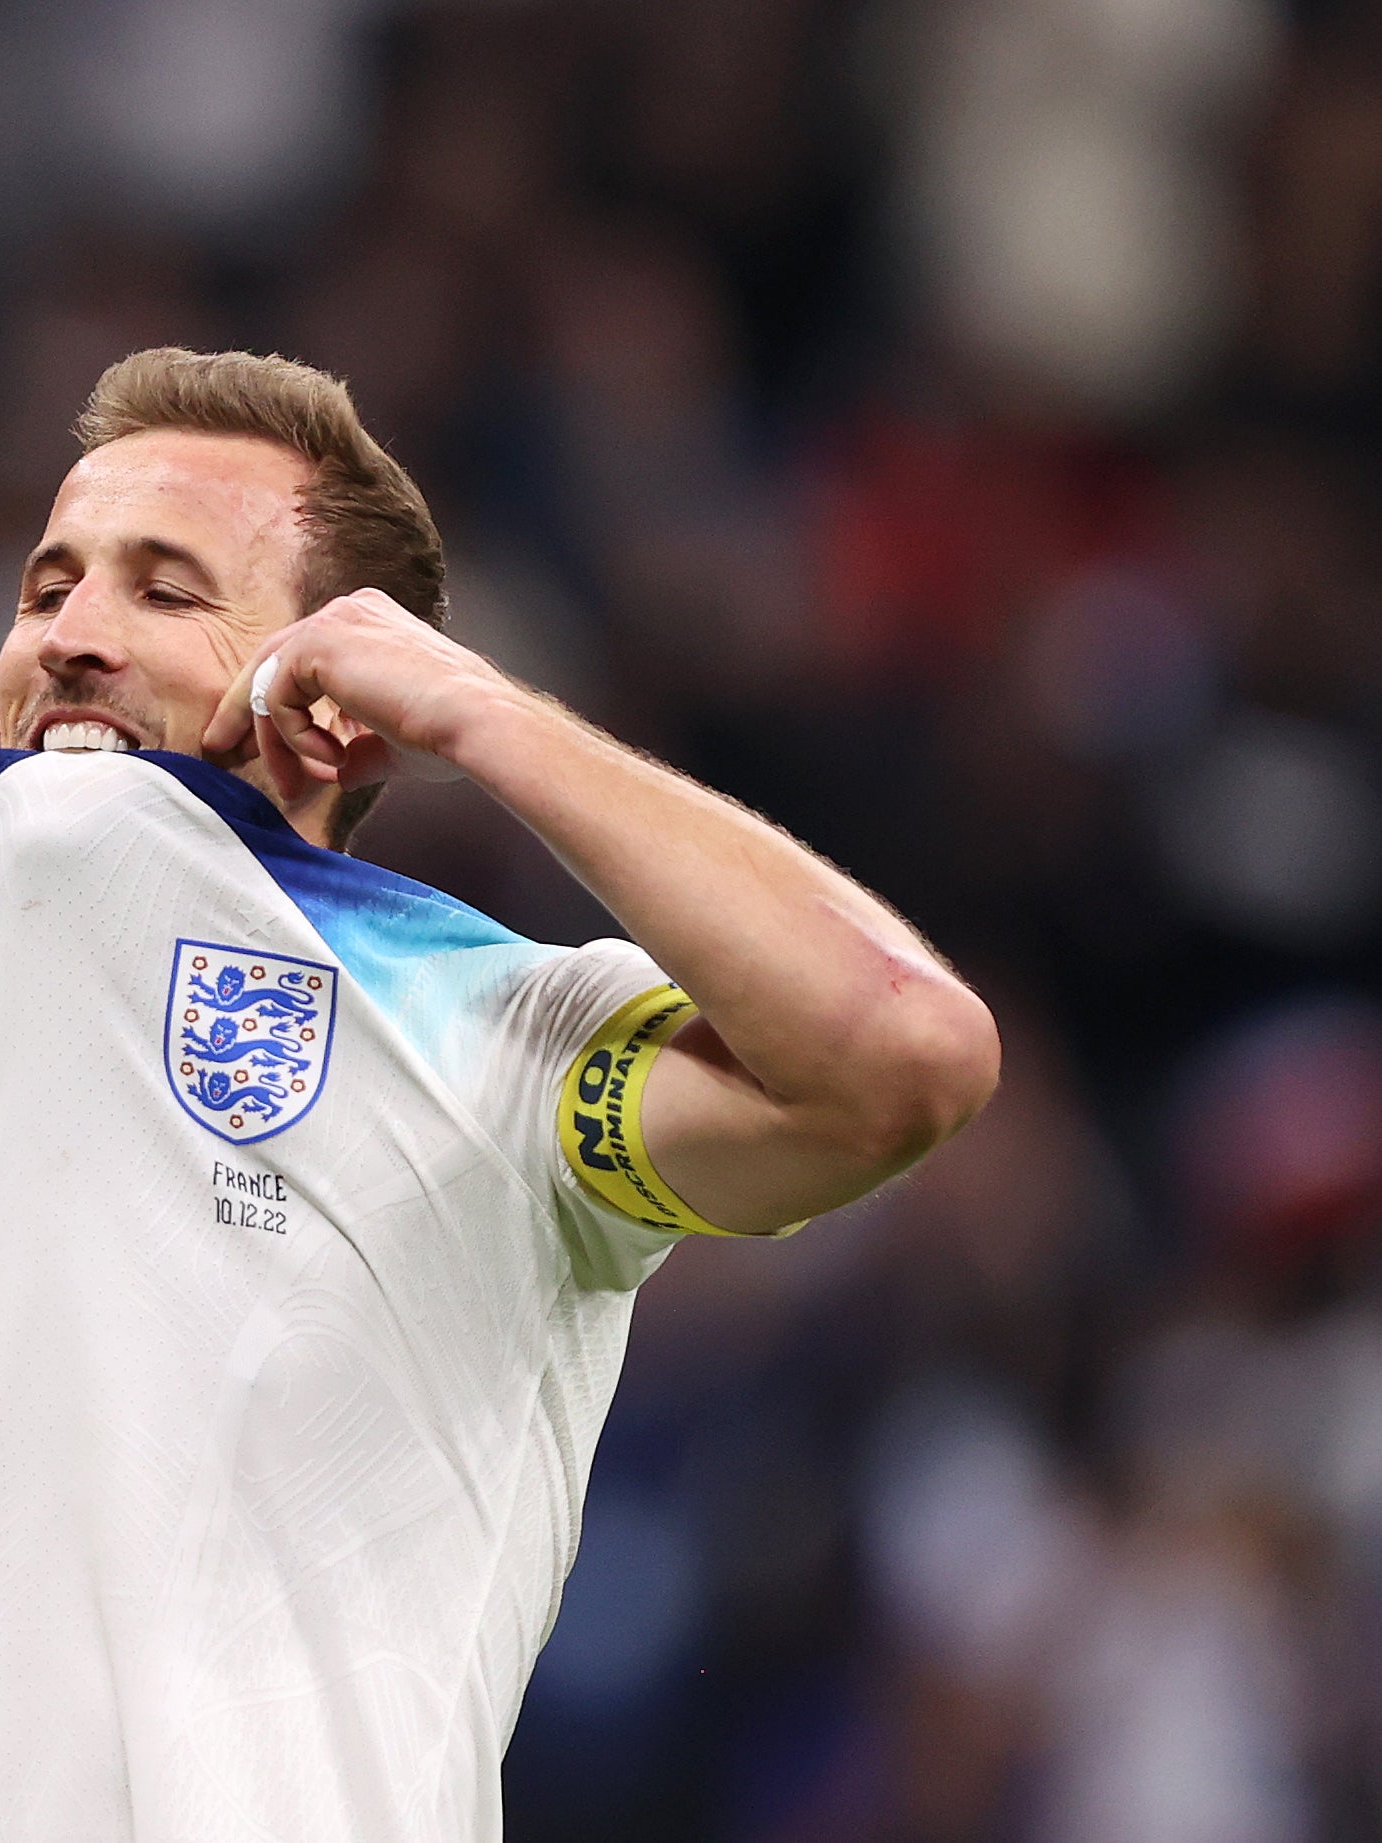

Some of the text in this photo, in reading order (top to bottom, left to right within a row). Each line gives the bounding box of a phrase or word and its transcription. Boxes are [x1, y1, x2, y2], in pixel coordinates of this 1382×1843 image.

[573, 1048, 618, 1172] NO
[605, 1000, 693, 1218] DISCRIMINATION
[212, 1160, 288, 1202] FRANCE
[213, 1196, 287, 1235] 10.12.22
